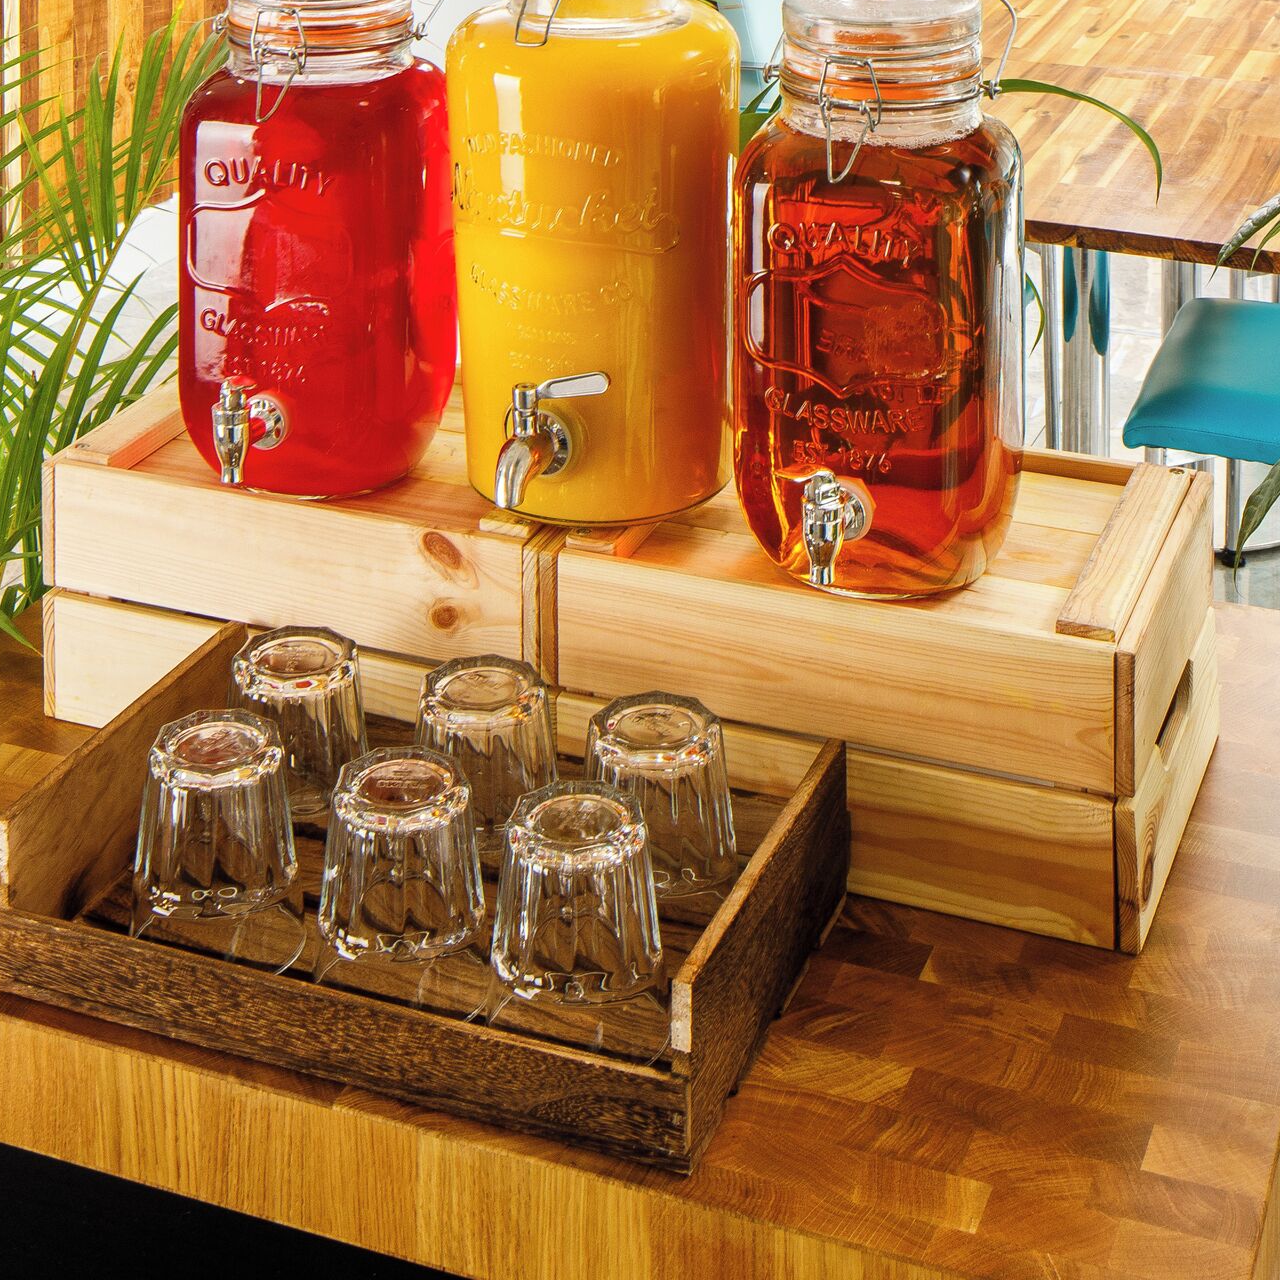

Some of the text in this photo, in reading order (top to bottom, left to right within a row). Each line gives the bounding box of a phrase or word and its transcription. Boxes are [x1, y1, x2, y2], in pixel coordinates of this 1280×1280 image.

[203, 155, 337, 196] QUALITY
[767, 221, 920, 270] QUALITY
[764, 385, 926, 435] GLASSWARE
